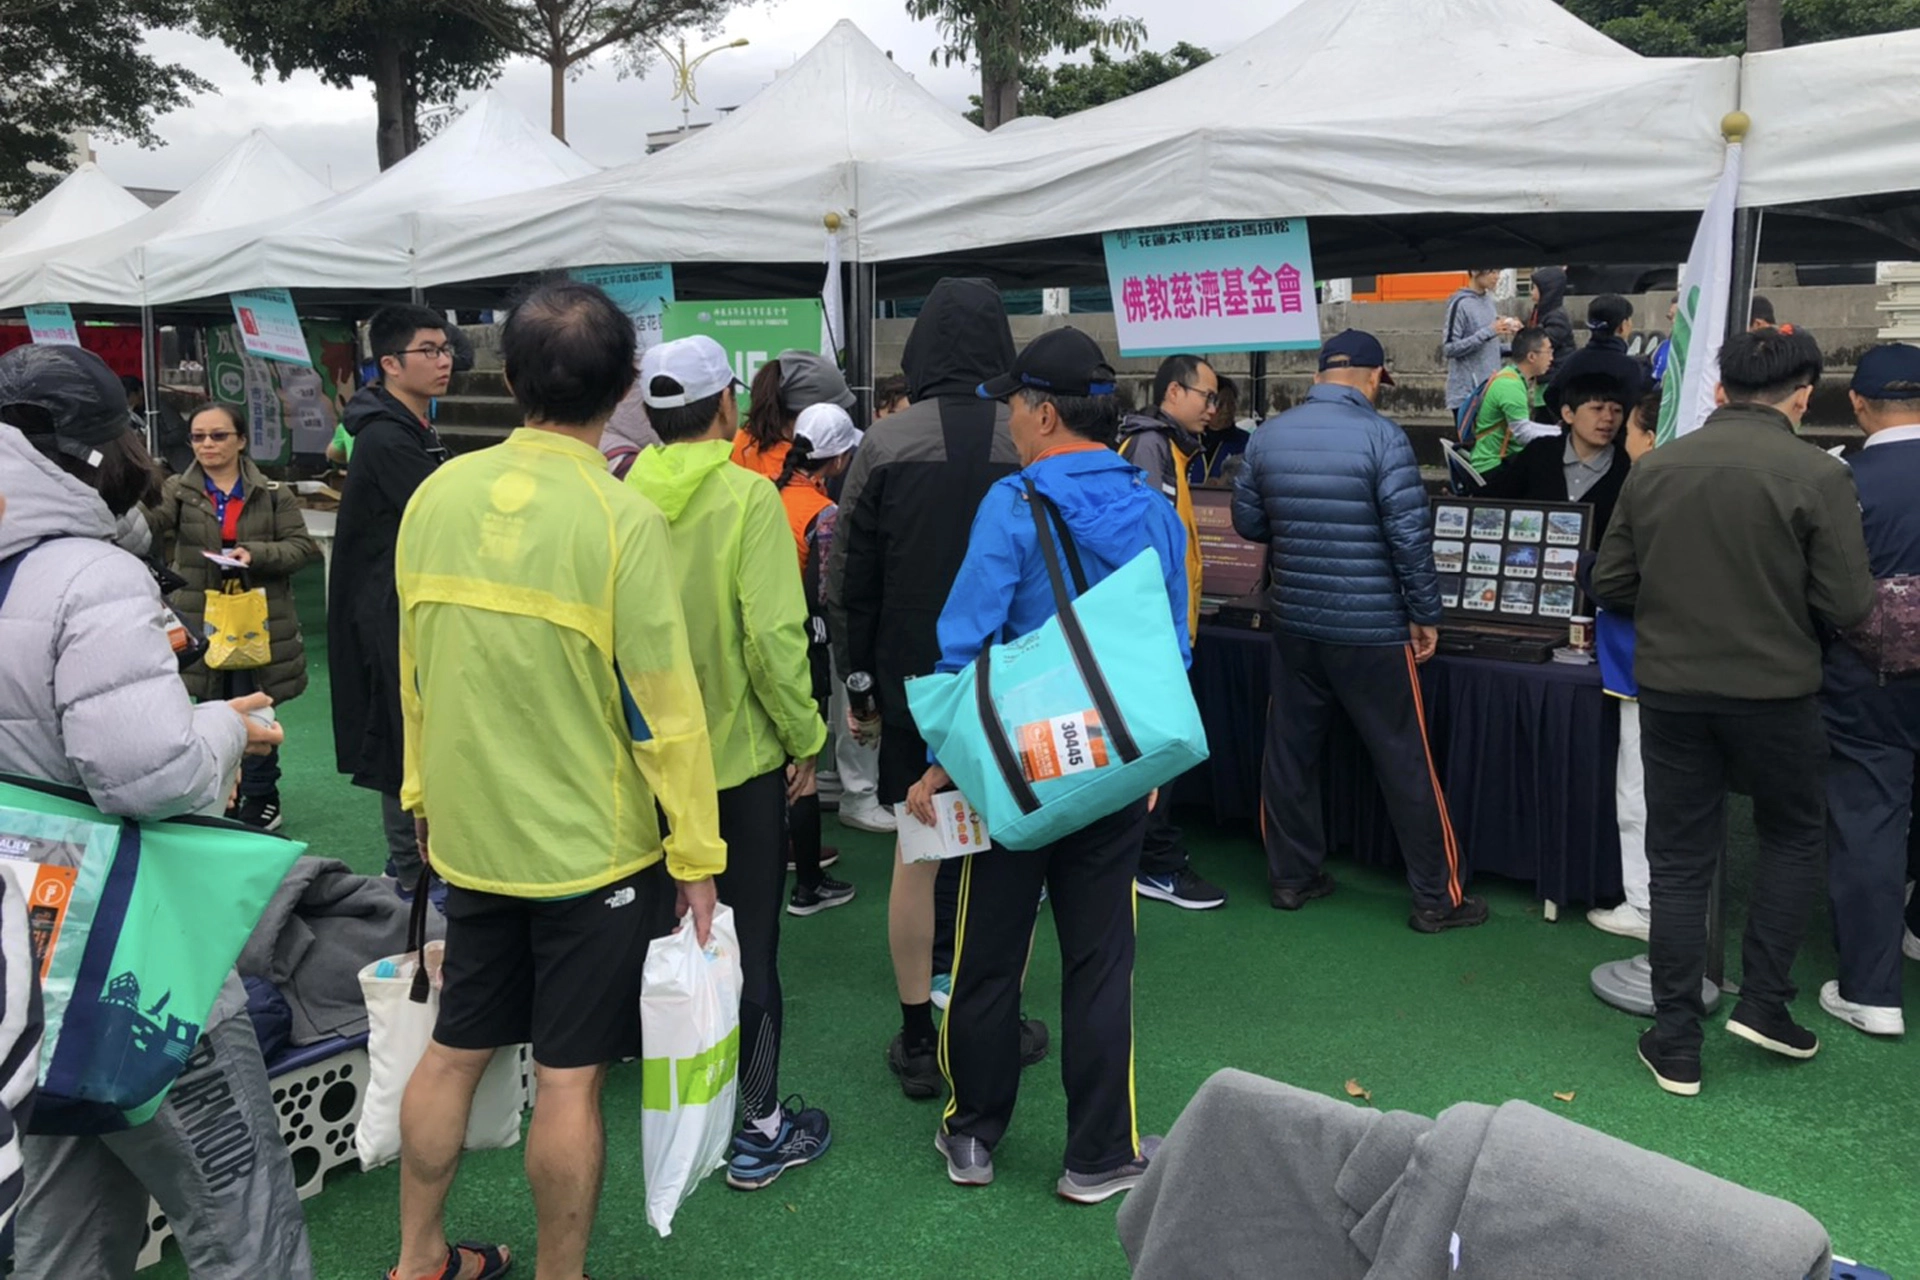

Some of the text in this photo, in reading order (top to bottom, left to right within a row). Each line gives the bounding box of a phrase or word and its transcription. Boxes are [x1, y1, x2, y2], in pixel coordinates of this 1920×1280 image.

[1121, 262, 1303, 323] 佛教慈濟基金會
[1060, 721, 1084, 766] 30445
[168, 1070, 258, 1193] ARMOUR
